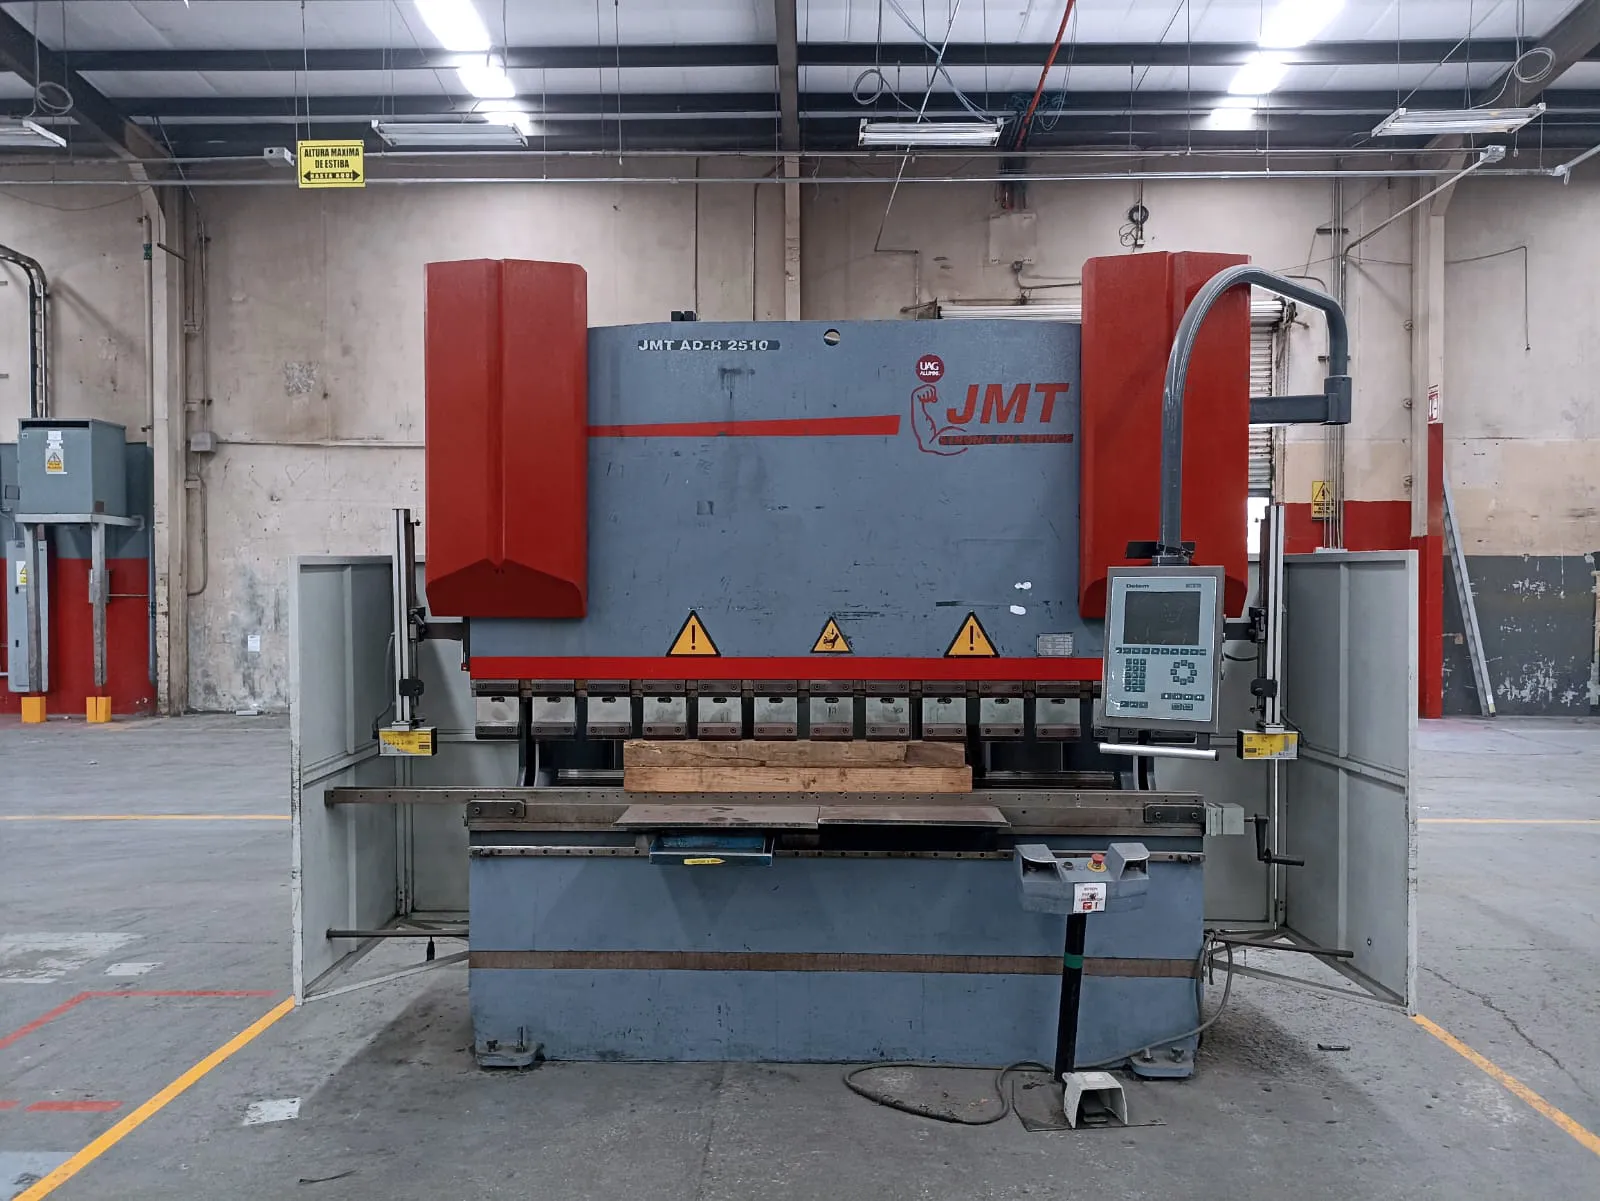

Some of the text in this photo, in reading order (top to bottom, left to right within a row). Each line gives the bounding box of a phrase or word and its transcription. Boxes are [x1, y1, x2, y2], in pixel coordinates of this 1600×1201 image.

[304, 148, 360, 157] ALTURA MAXIMA
[315, 160, 349, 168] DE ESTIBA
[638, 340, 675, 351] JMT
[728, 340, 769, 351] 2510
[946, 383, 1070, 424] JMT
